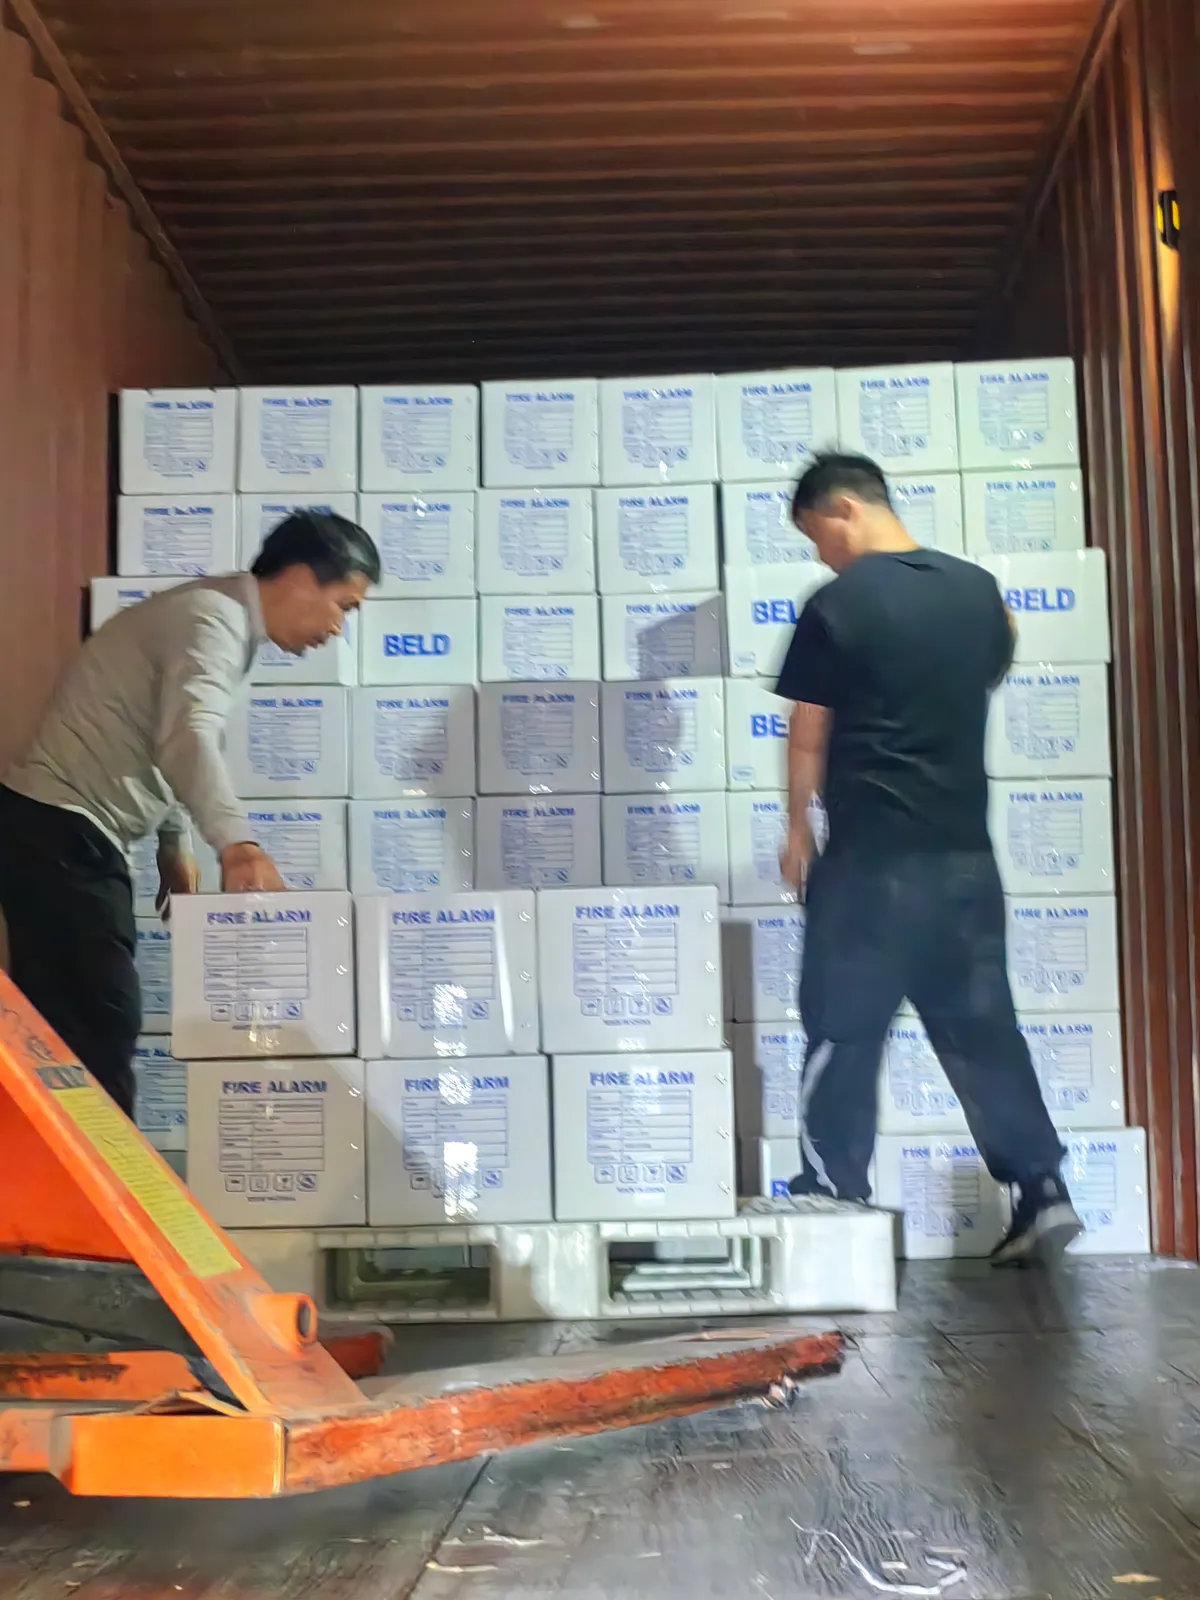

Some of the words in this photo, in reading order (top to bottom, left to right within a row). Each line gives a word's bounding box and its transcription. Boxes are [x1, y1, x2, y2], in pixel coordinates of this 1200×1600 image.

[1006, 588, 1075, 612] BELD
[752, 599, 799, 624] BEL
[384, 634, 451, 657] BELD
[1037, 675, 1080, 686] ALARM
[750, 714, 789, 738] BE
[1041, 791, 1084, 802] ALARM
[207, 911, 246, 924] FIRE
[252, 909, 312, 922] ALARM
[393, 911, 431, 924] FIRE
[437, 909, 495, 922] ALARM
[576, 907, 615, 920] FIRE
[620, 905, 680, 918] ALARM
[1047, 907, 1089, 918] ALARM
[590, 1073, 629, 1087] FIRE
[635, 1071, 695, 1085] ALARM
[222, 1082, 262, 1094] FIRE
[268, 1080, 328, 1092] ALARM
